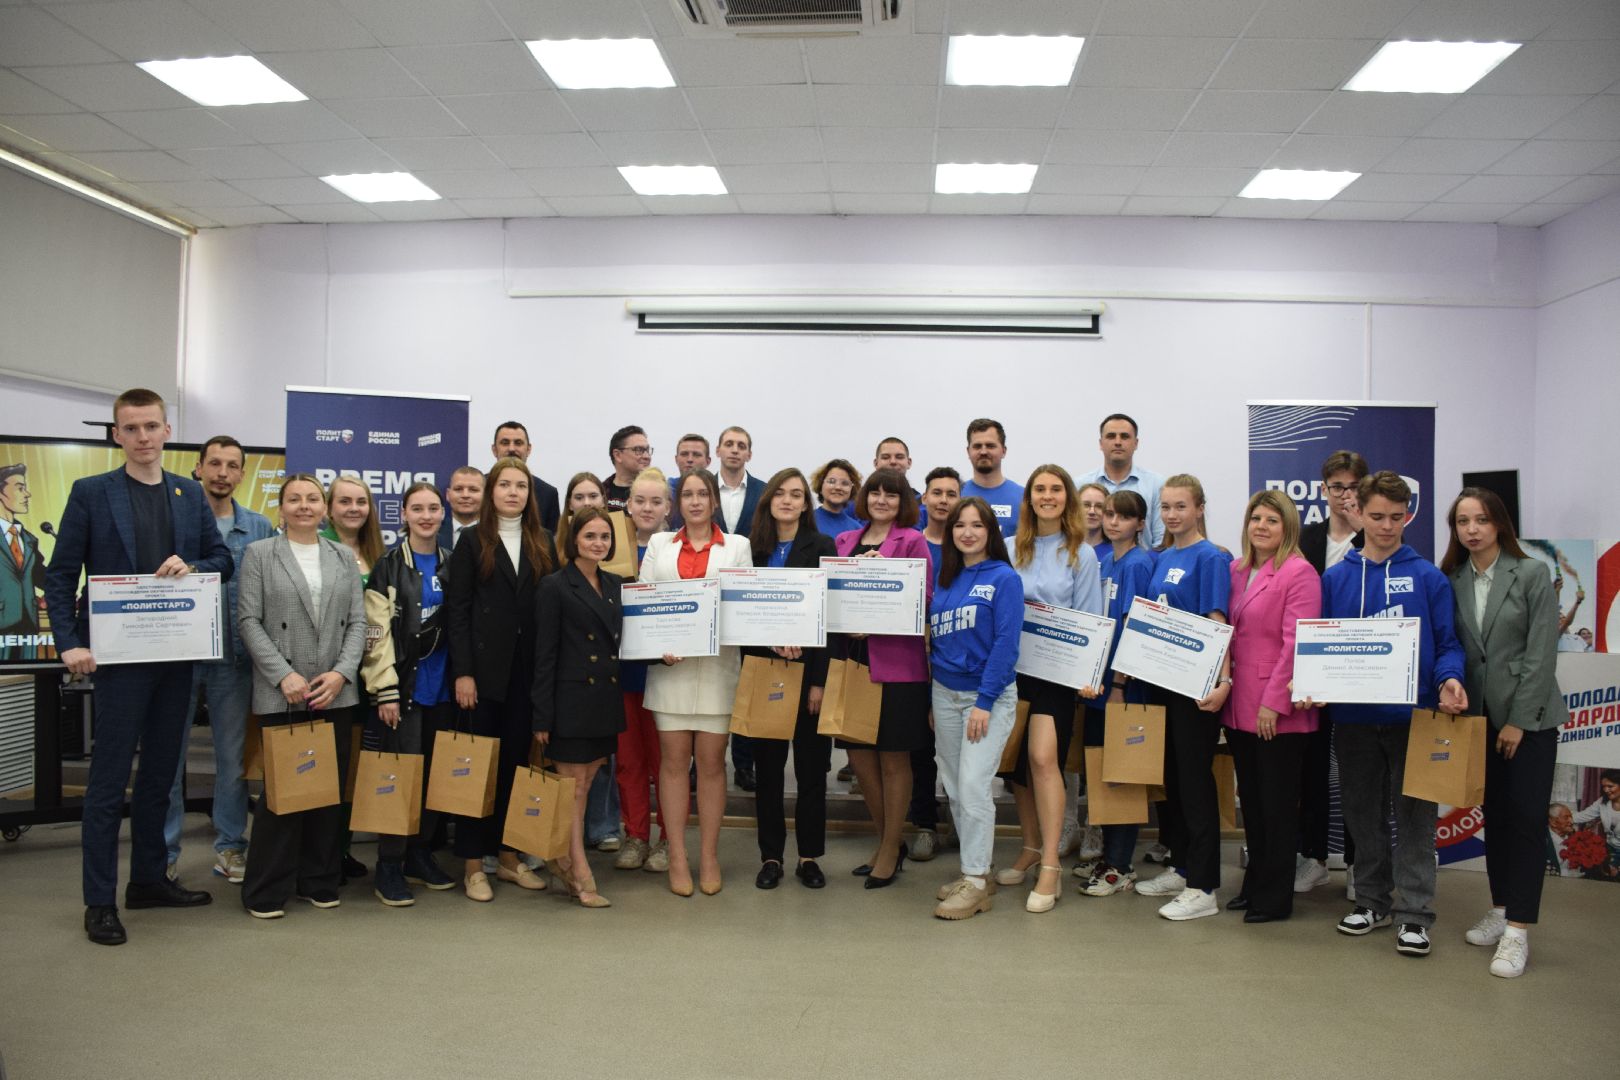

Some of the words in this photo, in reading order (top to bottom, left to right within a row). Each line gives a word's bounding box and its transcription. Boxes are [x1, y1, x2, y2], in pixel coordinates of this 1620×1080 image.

[368, 437, 400, 445] РОССИЯ
[1265, 479, 1328, 501] ПОЛ
[843, 581, 900, 589] «ПОЛИТСТАРТ»
[742, 592, 801, 600] «ПОЛИТСТАРТ»
[122, 601, 190, 610] «ПОЛИТСТАРТ»
[643, 604, 695, 613] «ПОЛИТСТАРТ»
[1036, 627, 1086, 644] «ПОЛИТСТАРТ»
[1148, 627, 1201, 649] «ПОЛИТСТАРТ»
[1563, 687, 1620, 709] ОЛОД
[1606, 724, 1620, 736] РО
